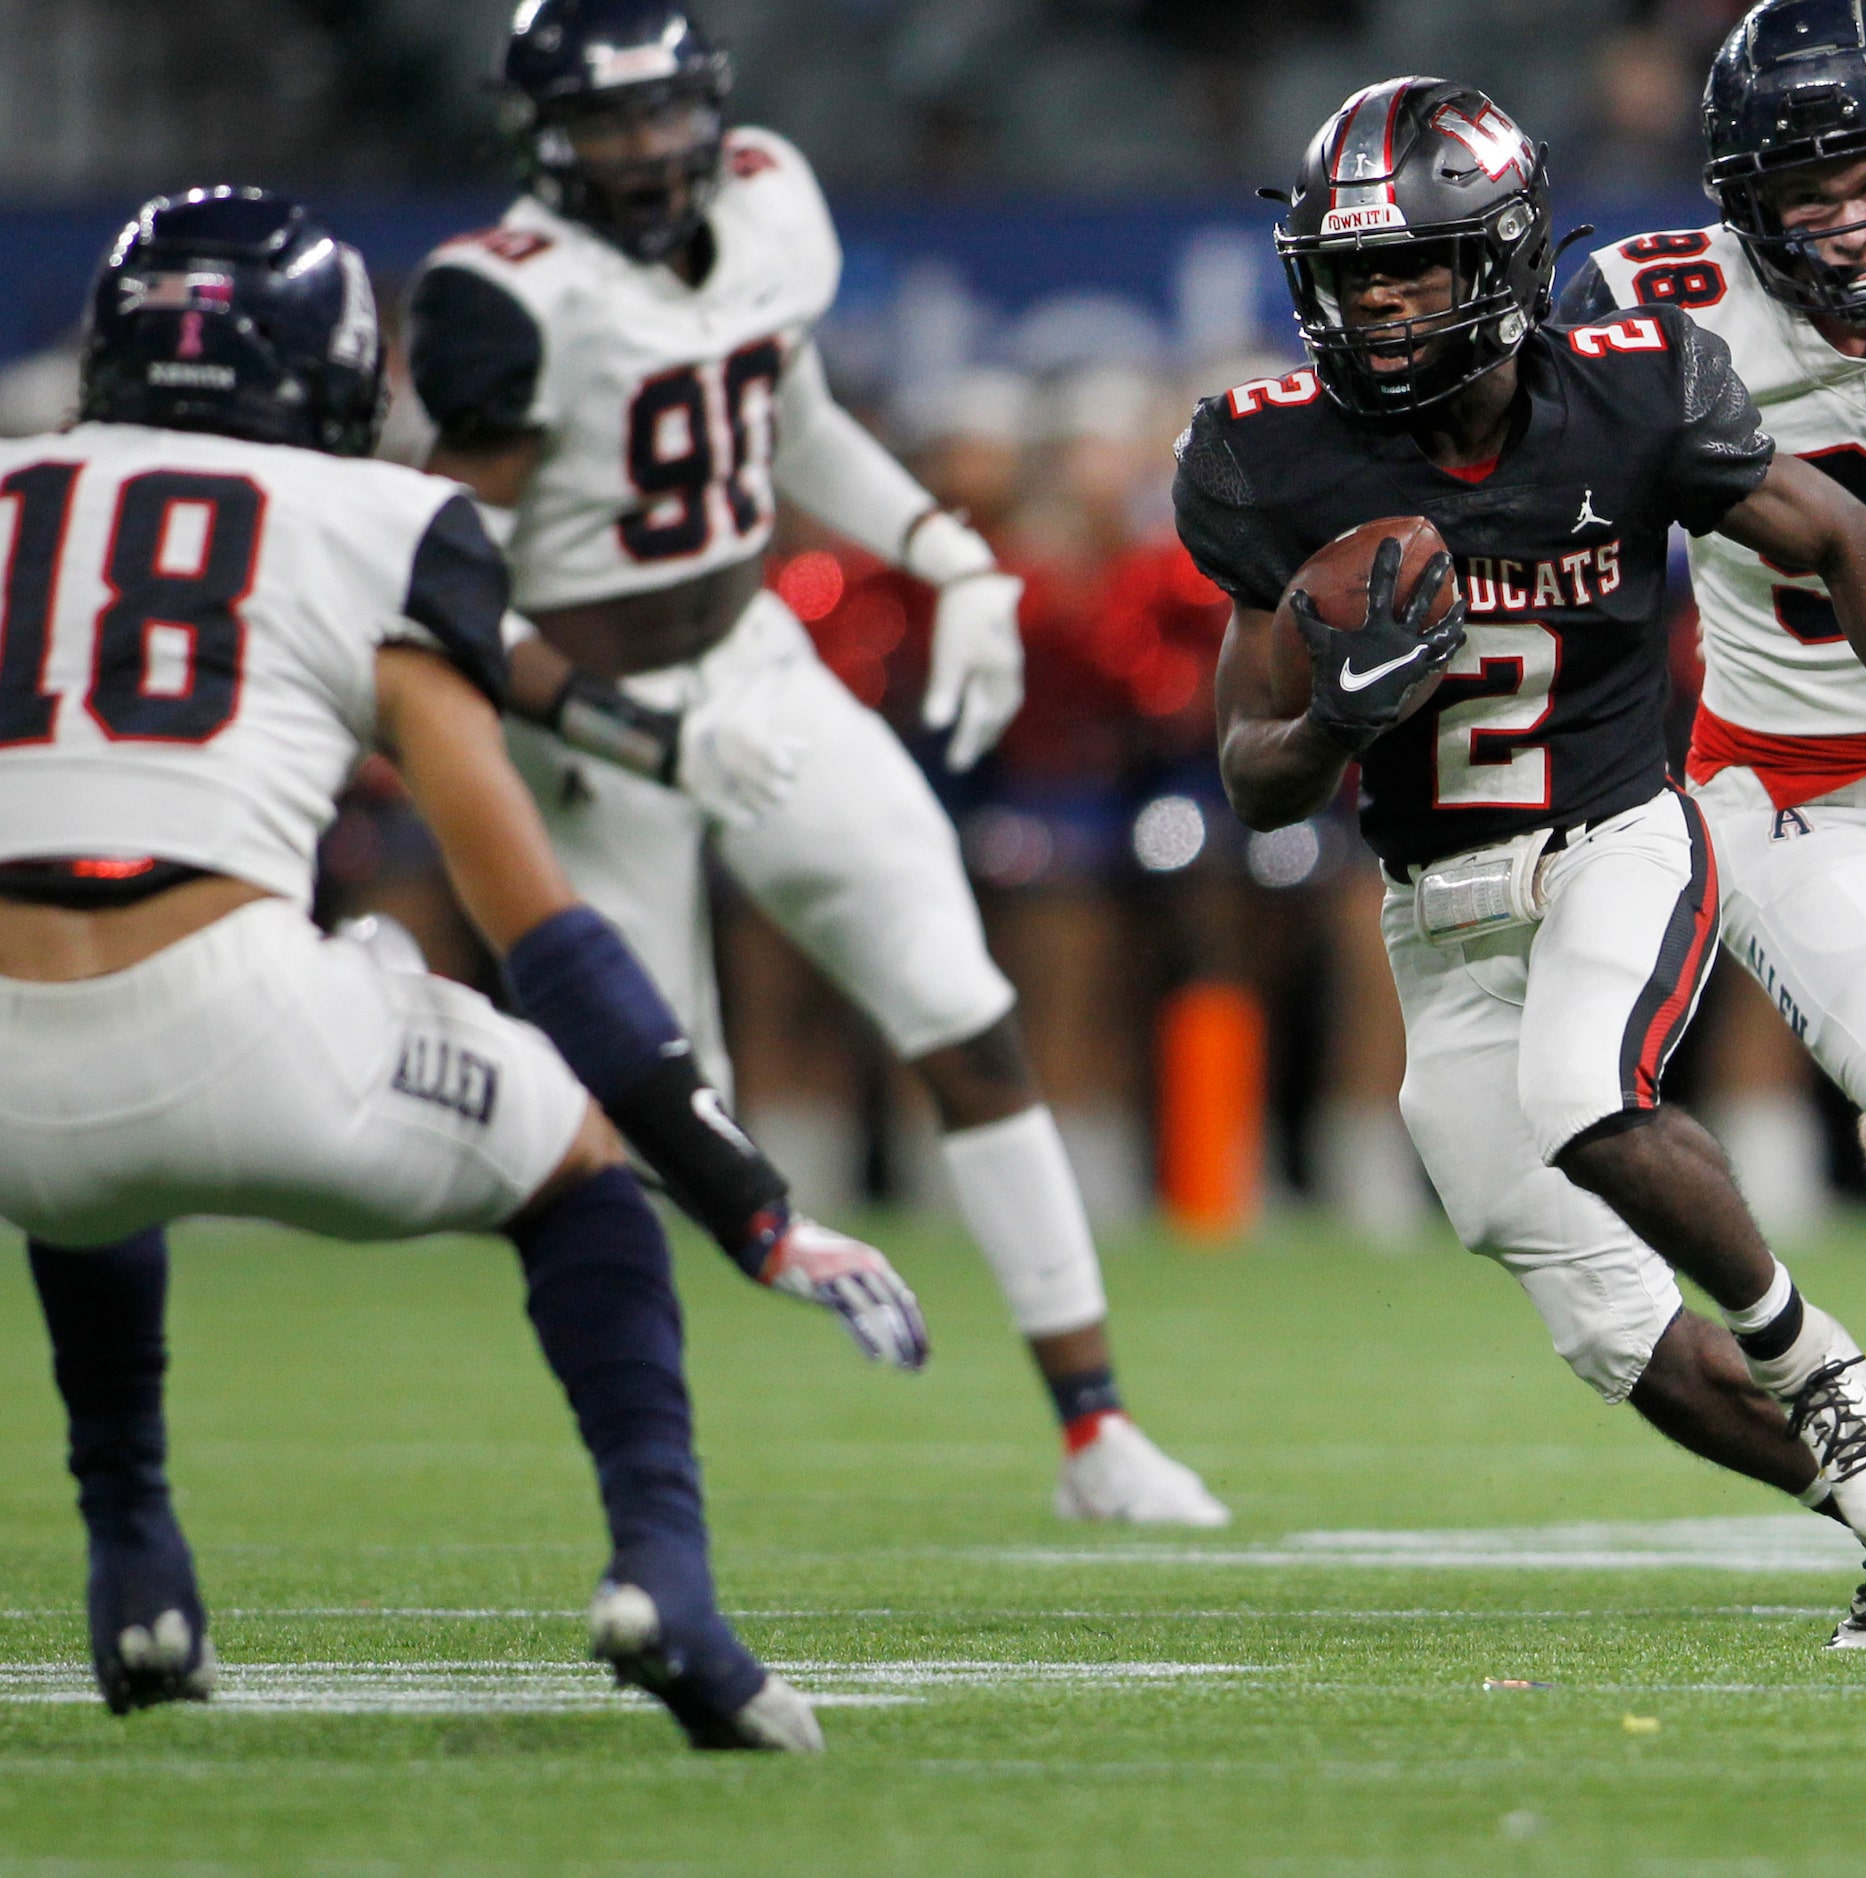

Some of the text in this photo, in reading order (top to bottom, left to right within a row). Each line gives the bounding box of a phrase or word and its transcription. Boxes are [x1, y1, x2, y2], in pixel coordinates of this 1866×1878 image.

[1328, 209, 1380, 231] OWN IT
[1617, 231, 1728, 310] 98
[1567, 316, 1669, 359] 2
[1226, 369, 1322, 420] 2
[614, 331, 792, 562] 90
[0, 456, 270, 748] 18
[1432, 619, 1563, 810] 2
[1770, 806, 1814, 843] A
[391, 1035, 502, 1128] ALLEN
